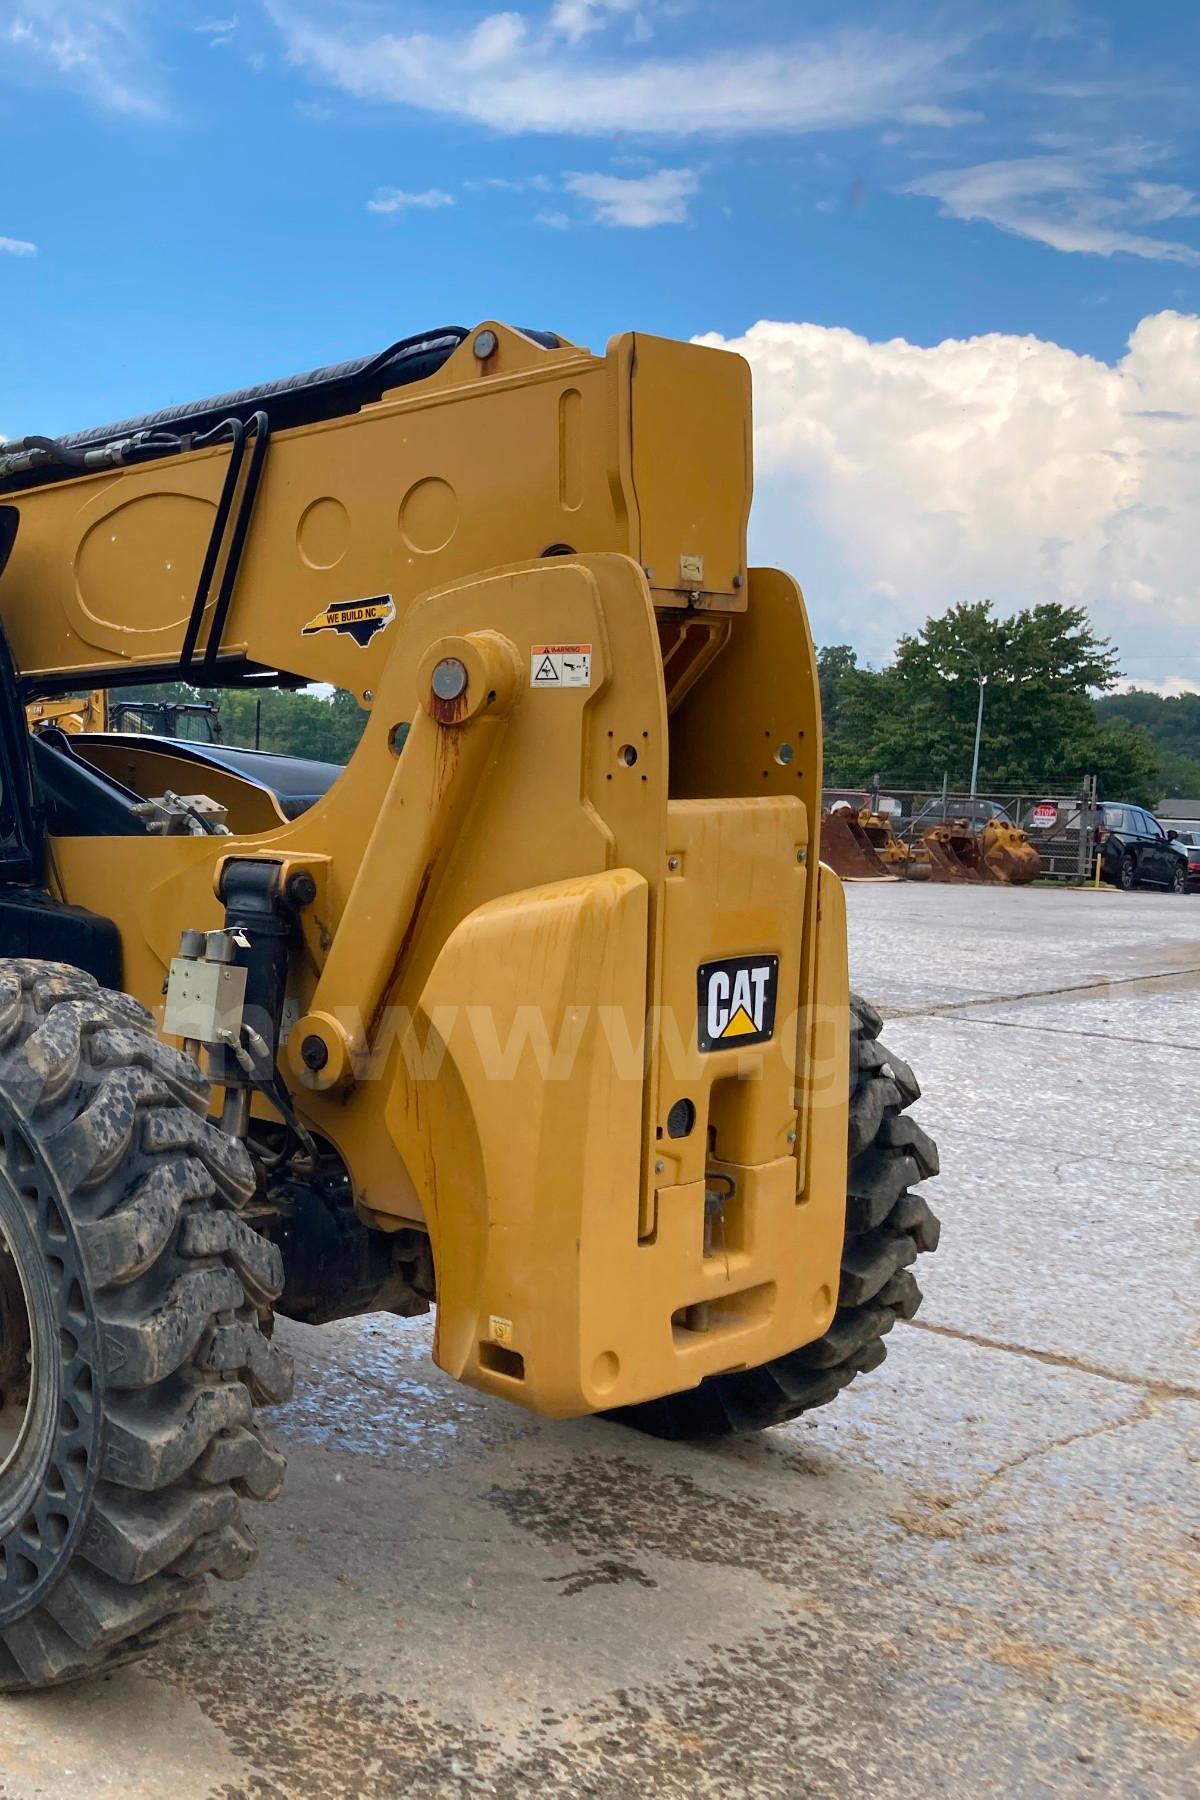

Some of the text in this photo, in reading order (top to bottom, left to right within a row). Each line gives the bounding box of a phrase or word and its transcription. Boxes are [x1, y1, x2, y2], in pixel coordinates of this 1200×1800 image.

[326, 607, 377, 624] WE BUILD NC
[1035, 808, 1055, 816] STOP
[707, 966, 770, 1039] CAT
